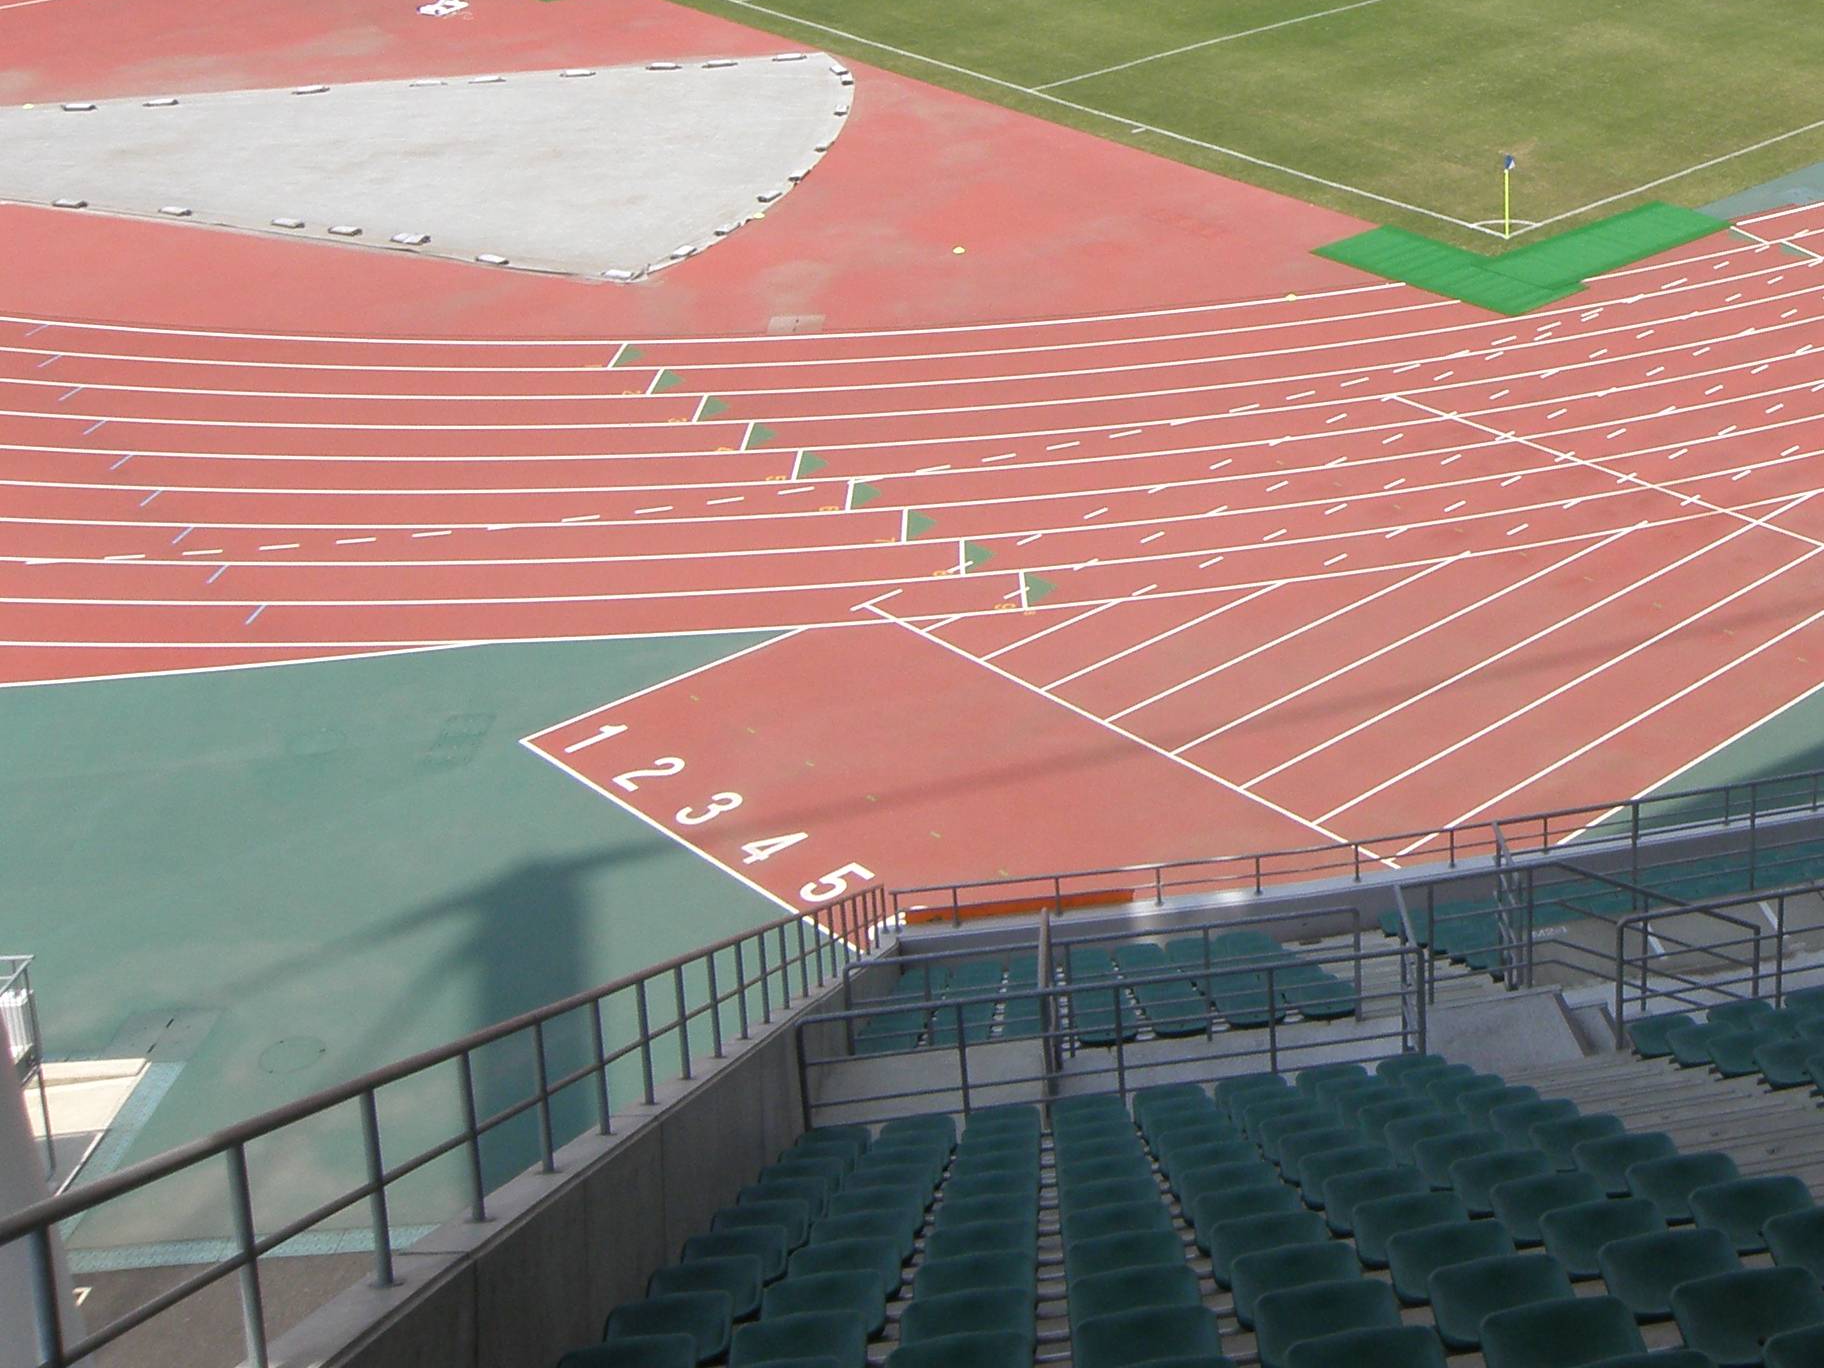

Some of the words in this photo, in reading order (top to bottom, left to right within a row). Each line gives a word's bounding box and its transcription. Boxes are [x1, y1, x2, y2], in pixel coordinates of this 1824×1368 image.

[564, 723, 628, 753] 1
[611, 756, 686, 793] 2
[675, 791, 744, 826] 3
[740, 831, 809, 865] 4
[799, 862, 876, 904] 5
